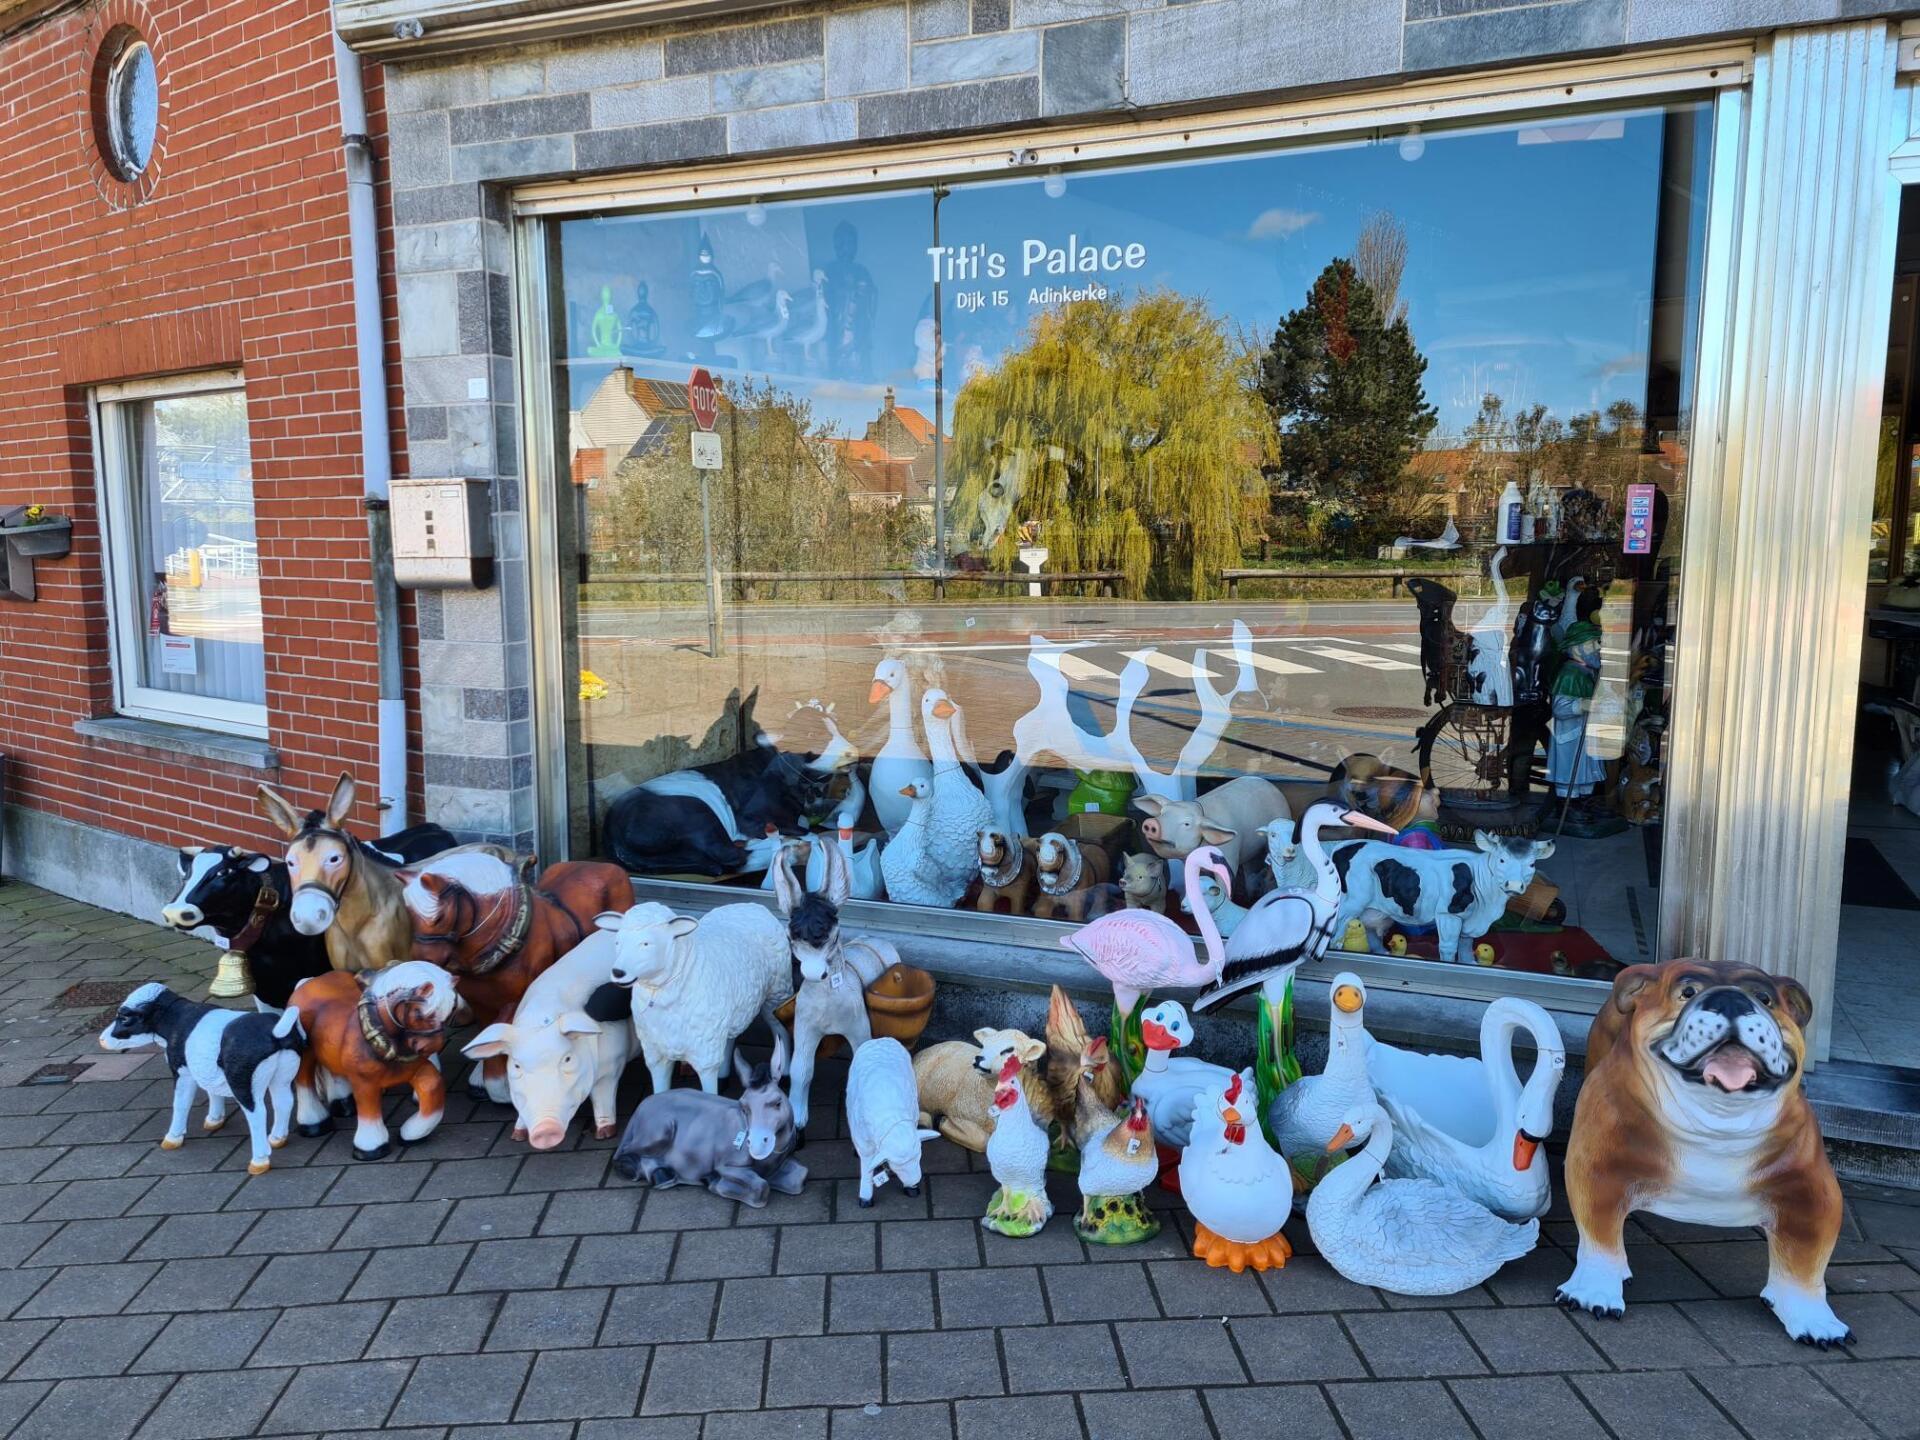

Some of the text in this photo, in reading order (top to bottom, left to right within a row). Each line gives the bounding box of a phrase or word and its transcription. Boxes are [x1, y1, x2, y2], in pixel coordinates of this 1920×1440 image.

[927, 234, 1147, 283] Titi's Palace
[957, 283, 1108, 313] Dijk 15 Adinkerke
